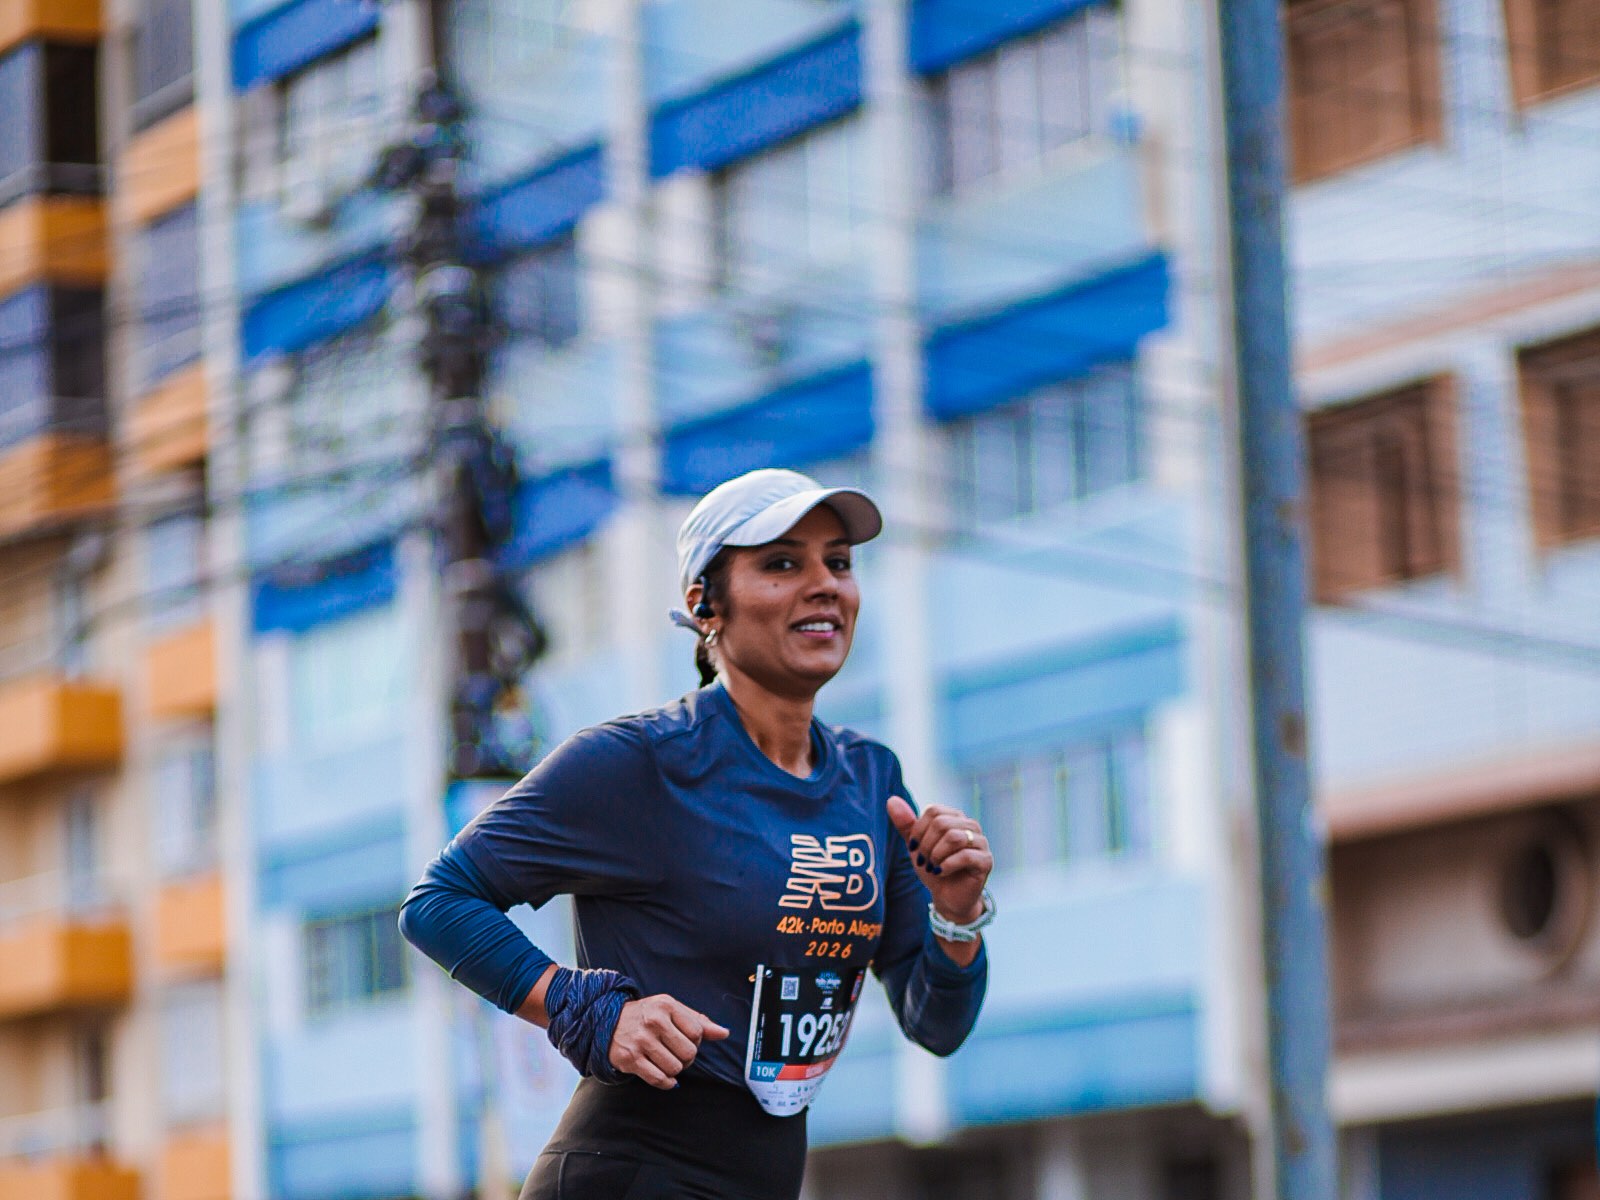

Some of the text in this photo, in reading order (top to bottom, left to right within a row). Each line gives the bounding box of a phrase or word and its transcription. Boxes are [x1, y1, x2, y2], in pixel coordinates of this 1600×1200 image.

[811, 917, 845, 935] Porto
[804, 941, 853, 959] 2026
[756, 1065, 777, 1078] 10K
